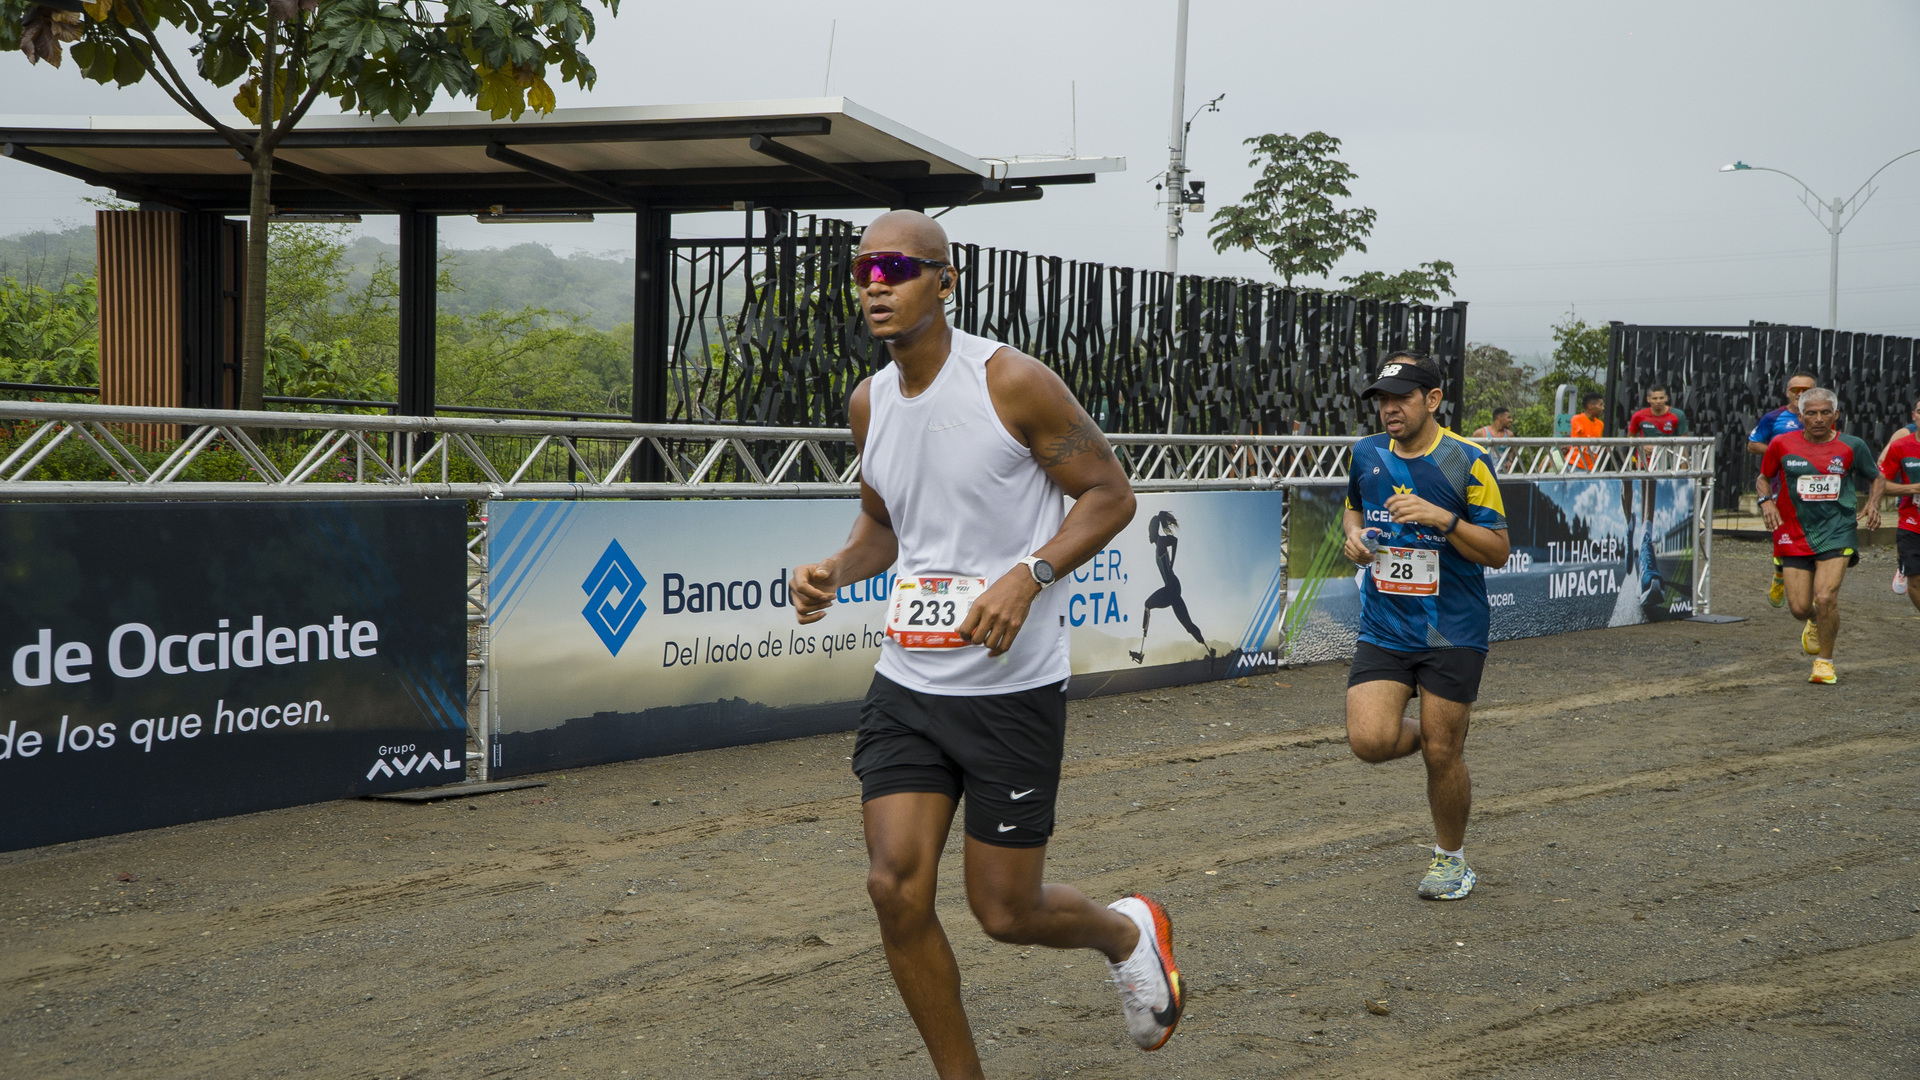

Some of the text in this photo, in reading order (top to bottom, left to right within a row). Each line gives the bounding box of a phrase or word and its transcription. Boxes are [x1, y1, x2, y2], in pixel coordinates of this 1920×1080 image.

[1809, 483, 1829, 493] 594
[1069, 550, 1128, 585] CER,
[1547, 538, 1621, 566] TU HACER,
[1390, 562, 1413, 580] 28
[1549, 569, 1621, 600] IMPACTA.
[663, 573, 762, 615] Banco
[1069, 591, 1128, 627] CTA.
[1669, 600, 1693, 614] AVAL
[908, 600, 956, 626] 233
[12, 615, 378, 687] de Occidente
[663, 624, 884, 667] Del lado de los que ha
[1237, 651, 1276, 668] AVAL
[0, 700, 330, 759] de los que hacen.
[366, 749, 461, 781] AVAL
[379, 743, 416, 756] Grupo
